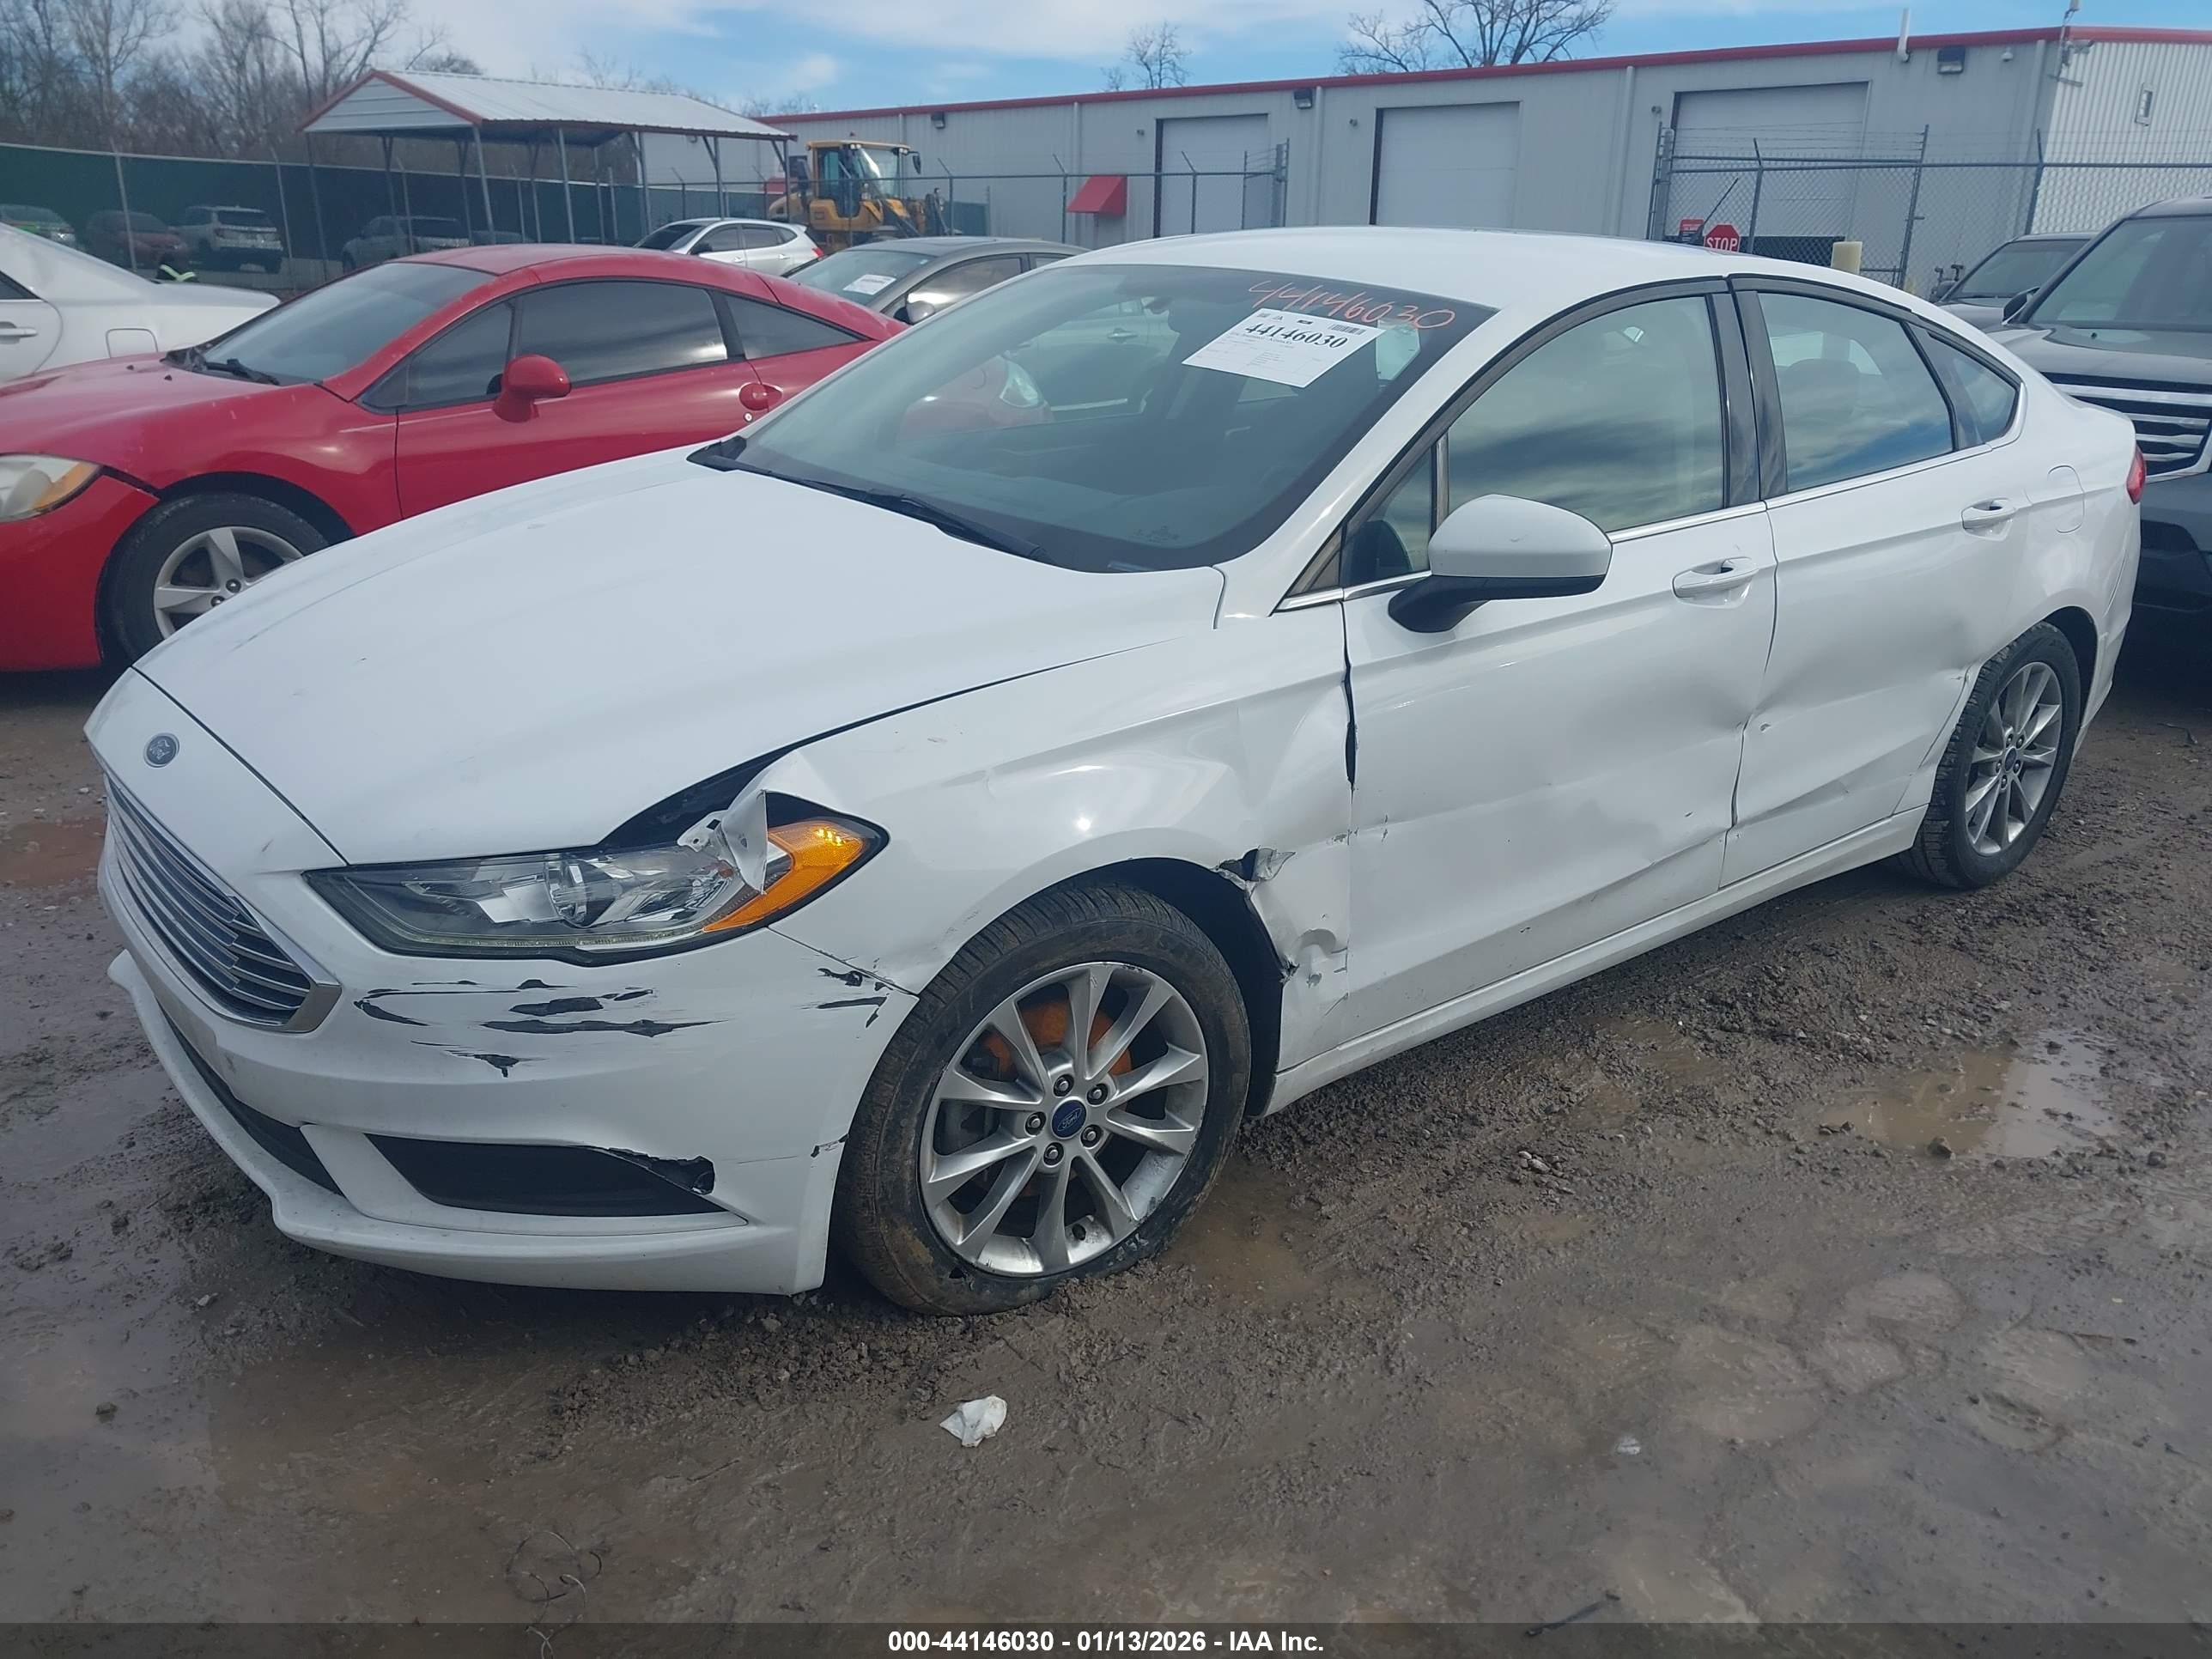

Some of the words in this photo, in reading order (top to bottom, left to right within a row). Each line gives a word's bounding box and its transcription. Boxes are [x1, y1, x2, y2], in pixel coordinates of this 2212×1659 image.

[1706, 237, 1739, 252] STOP
[1248, 280, 1455, 329] 44146030
[1244, 323, 1348, 349] 44146030
